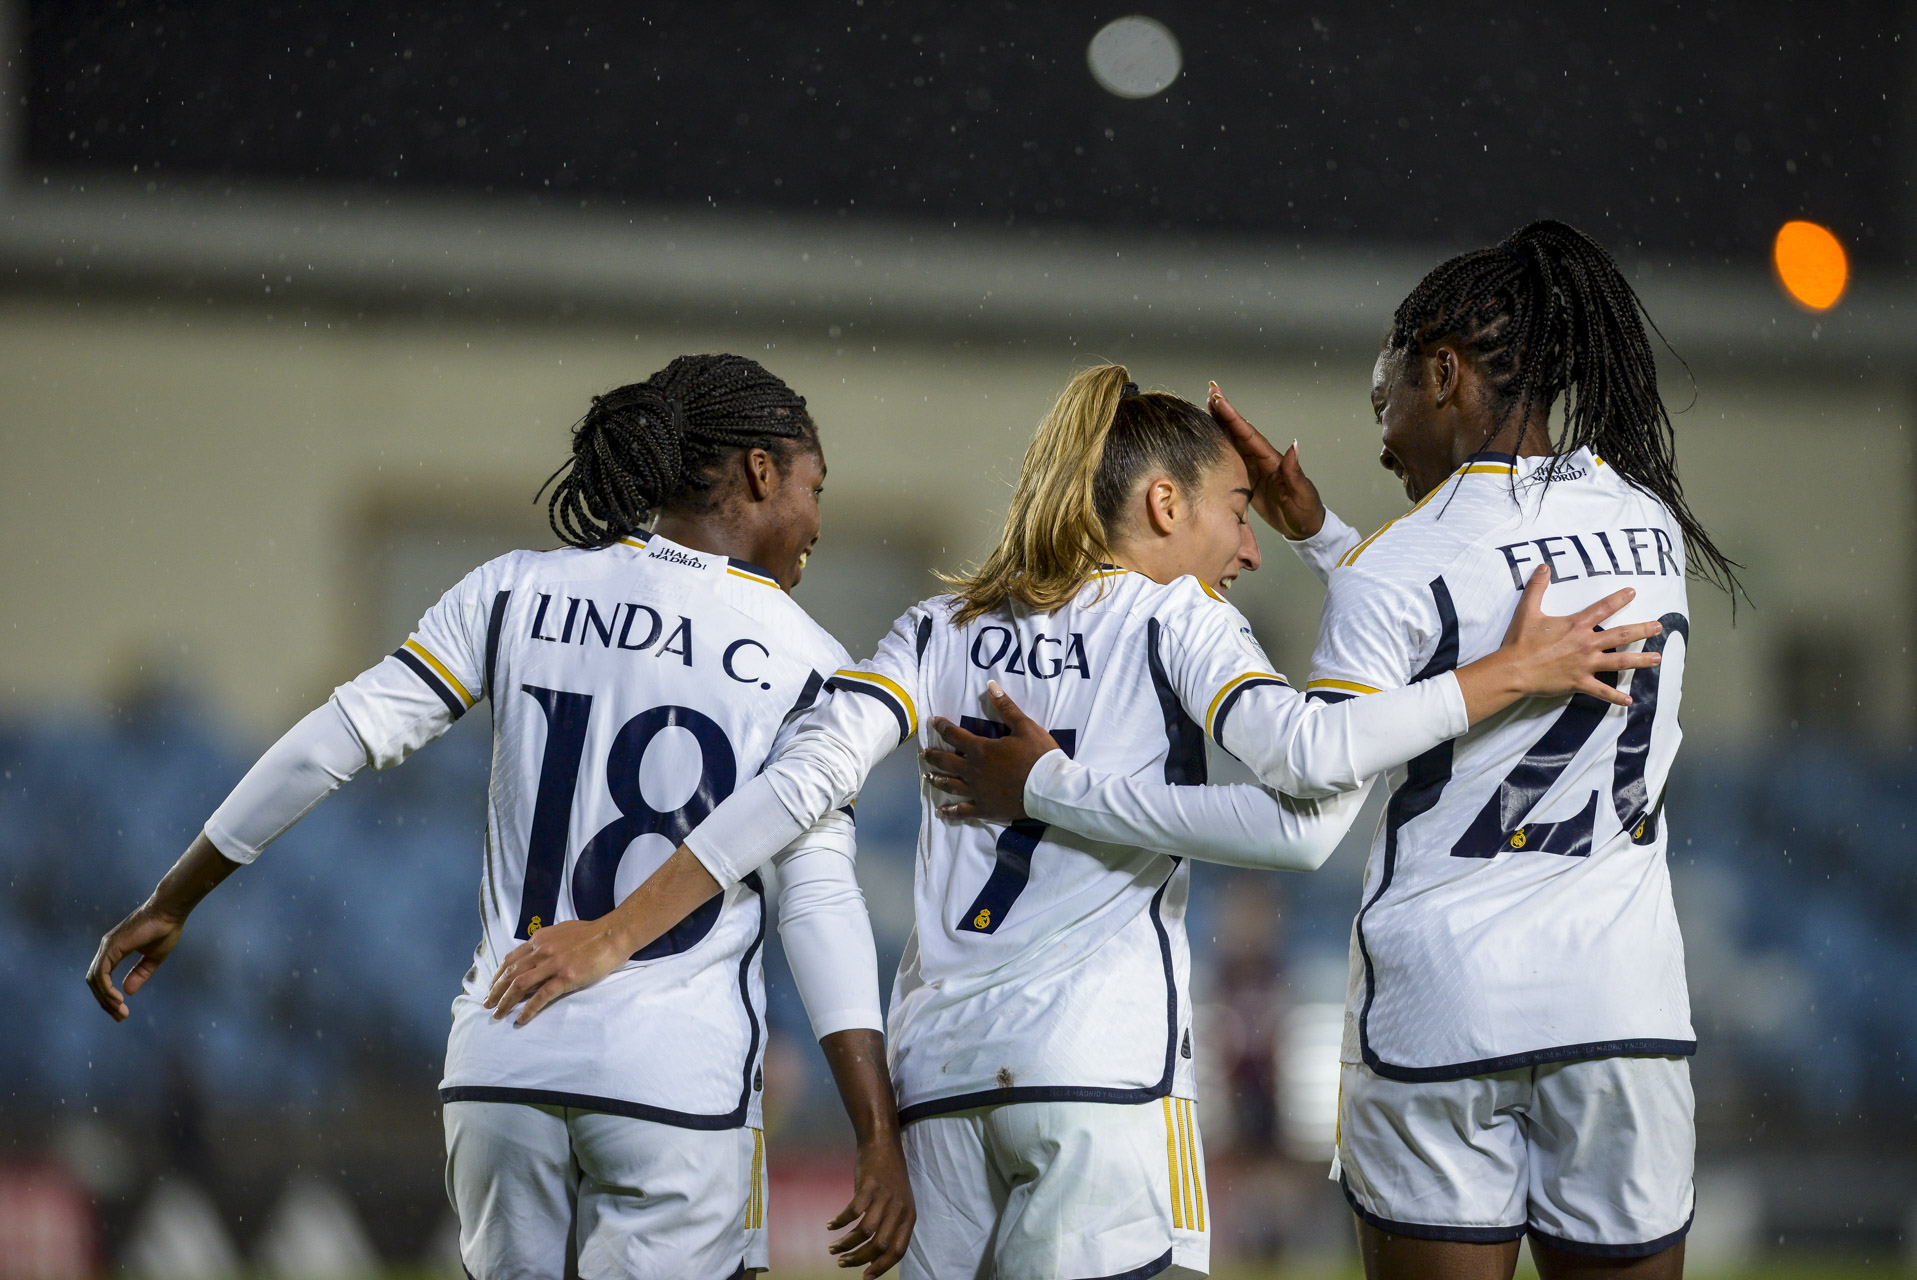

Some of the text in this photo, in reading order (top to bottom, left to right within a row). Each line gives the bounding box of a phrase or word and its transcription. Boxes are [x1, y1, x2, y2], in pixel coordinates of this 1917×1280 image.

[648, 552, 707, 570] MADRID!
[1495, 527, 1681, 591] FELLER
[531, 592, 771, 690] LINDA C.
[971, 626, 1091, 679] OLGA
[1450, 612, 1690, 858] 20
[514, 684, 737, 961] 18
